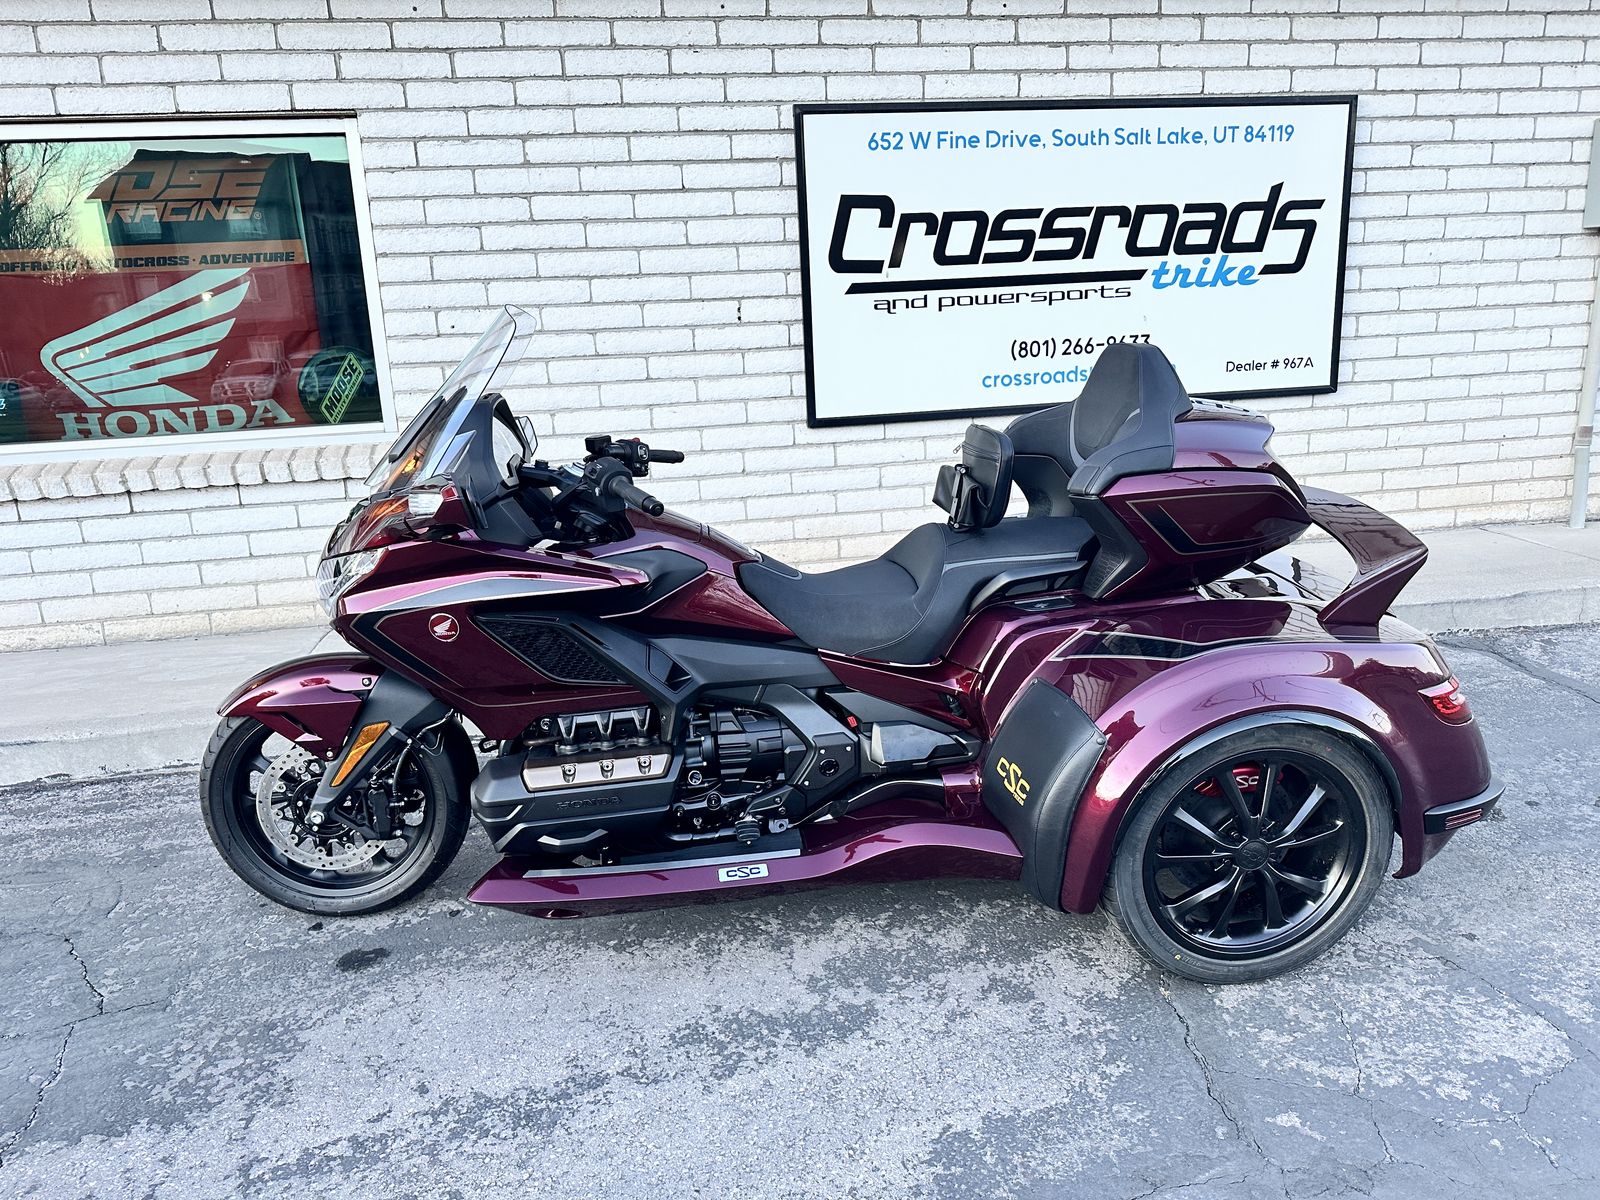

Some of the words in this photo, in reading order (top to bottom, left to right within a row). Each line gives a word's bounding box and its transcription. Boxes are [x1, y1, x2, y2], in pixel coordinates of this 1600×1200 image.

[867, 131, 904, 151] 652
[909, 131, 932, 150] W
[937, 130, 981, 149] Fine
[986, 129, 1046, 150] Drive,
[1052, 128, 1110, 147] South
[1114, 127, 1152, 146] Salt
[1157, 126, 1208, 146] Lake,
[1213, 125, 1240, 144] UT
[1244, 124, 1295, 143] 84119
[828, 181, 1326, 276] Crossroads
[198, 251, 295, 265] ADVENTURE
[1151, 254, 1263, 290] trike
[873, 292, 928, 314] and
[938, 286, 1131, 311] powersports
[1011, 337, 1056, 361] (801)
[1225, 359, 1267, 373] Dealer
[1270, 359, 1280, 370] #
[1283, 356, 1314, 369] 967A
[323, 358, 358, 418] MOOSE
[56, 399, 296, 440] HONDA
